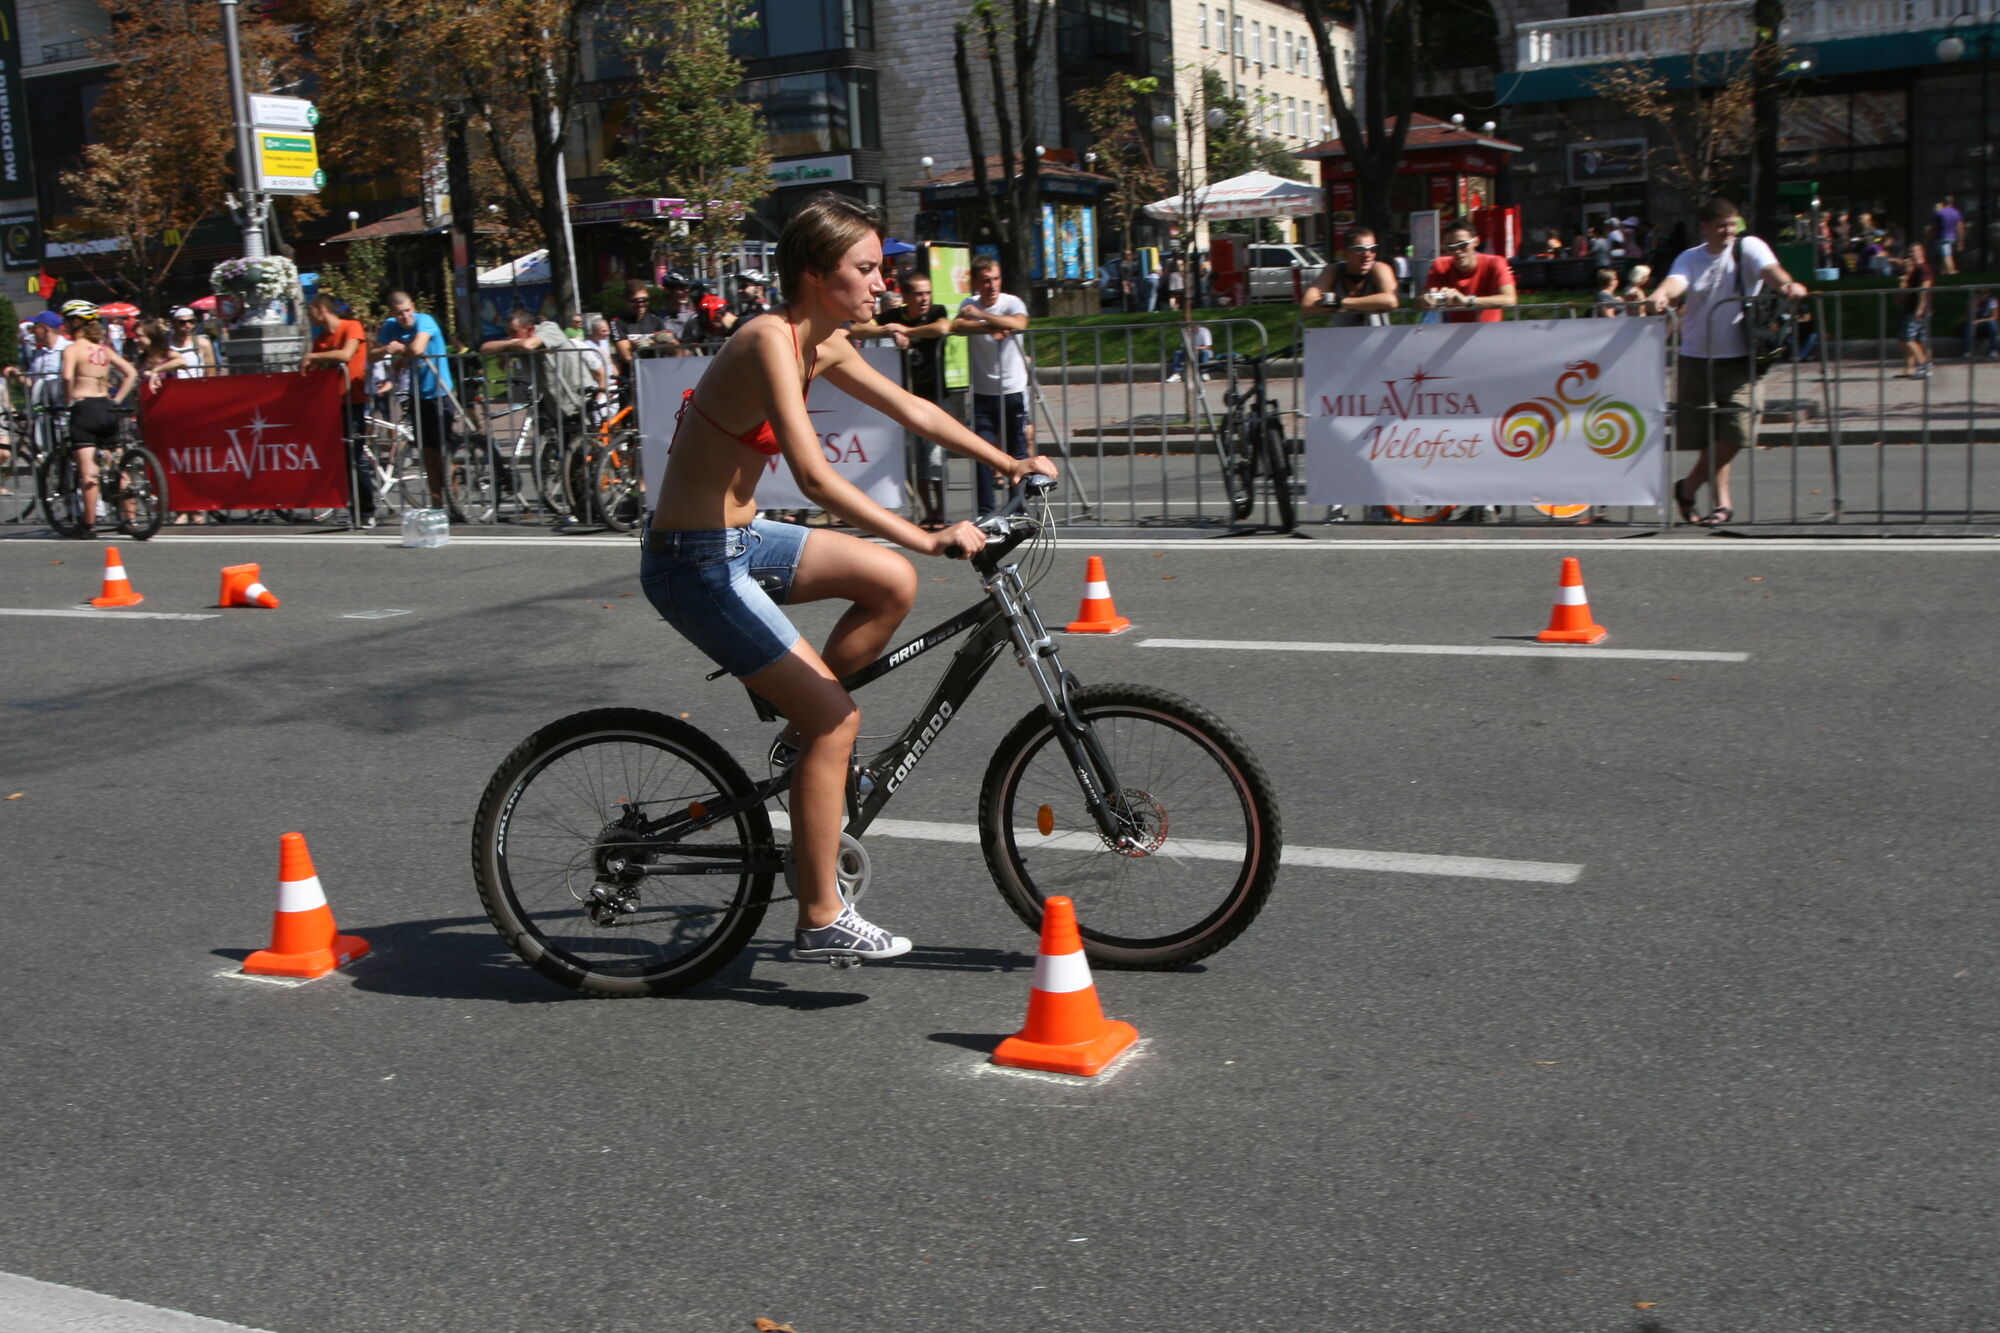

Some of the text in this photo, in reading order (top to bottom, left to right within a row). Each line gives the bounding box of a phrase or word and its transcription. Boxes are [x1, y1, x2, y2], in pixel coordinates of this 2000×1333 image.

[0, 58, 17, 182] McDonal
[1319, 380, 1482, 421] MILAVITSA
[169, 428, 321, 480] MILAVITSA
[1362, 424, 1484, 470] Velofest
[889, 638, 925, 667] ARDI
[886, 700, 953, 795] CORRADO
